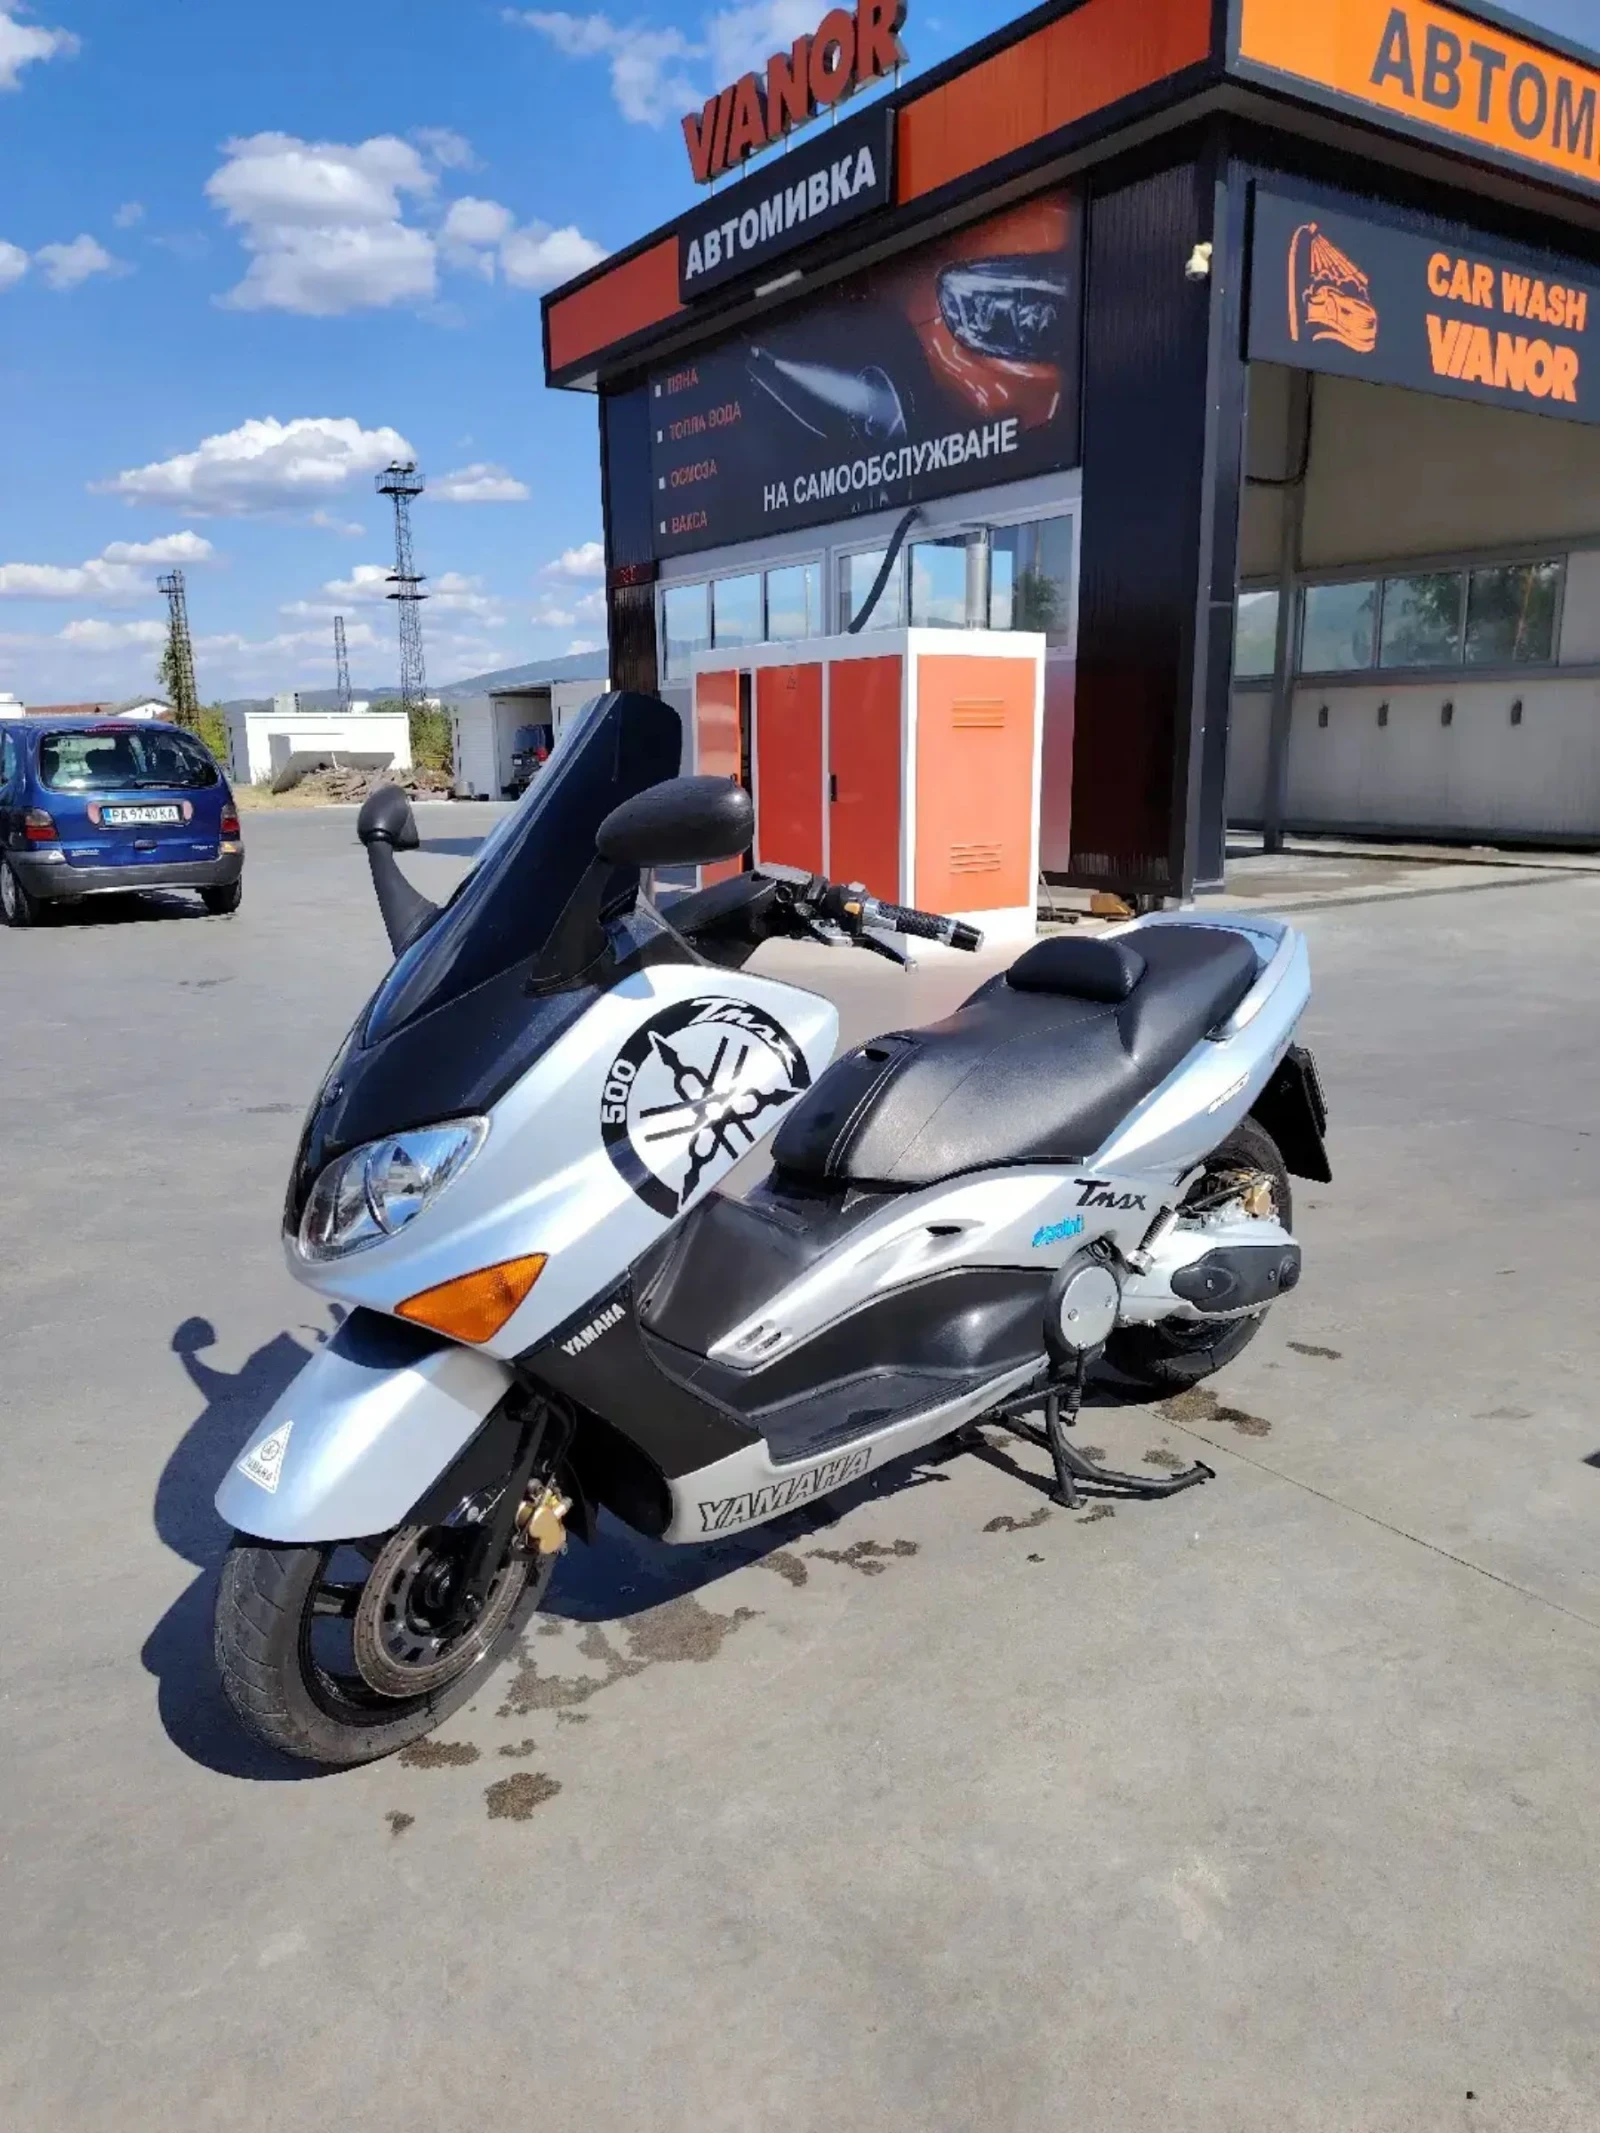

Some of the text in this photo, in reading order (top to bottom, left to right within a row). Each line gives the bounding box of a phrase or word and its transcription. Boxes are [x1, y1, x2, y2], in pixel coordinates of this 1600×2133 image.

[681, 0, 908, 184] VIANOR
[1369, 7, 1600, 166] АВТОМ
[685, 146, 876, 280] АВТОМИВКА
[1427, 252, 1588, 331] CAR WASH
[1426, 314, 1579, 403] VIANOR
[669, 401, 741, 440] ТОПЛА ВОДА
[670, 459, 717, 488] ОСМОЗА
[763, 417, 1019, 511] НА САМООБСЛУЖВАНЕ
[672, 511, 708, 534] ВАКСА
[601, 1058, 637, 1124] 500
[560, 1303, 626, 1356] YAMAHA
[698, 1447, 872, 1532] YAMAHA
